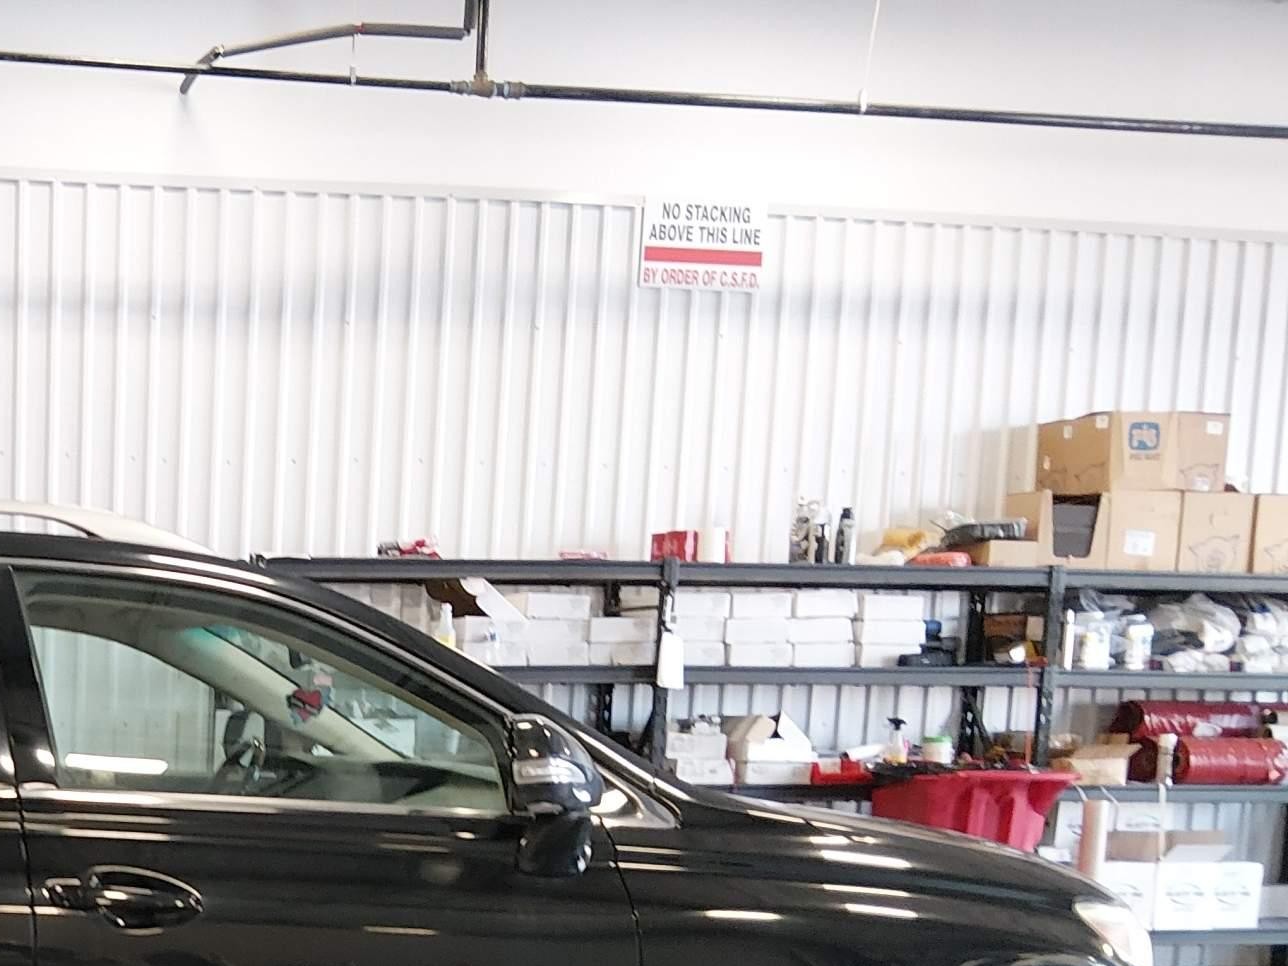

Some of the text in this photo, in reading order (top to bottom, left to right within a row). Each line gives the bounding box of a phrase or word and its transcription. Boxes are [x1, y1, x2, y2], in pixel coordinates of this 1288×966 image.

[662, 202, 751, 223] NO STACKING
[649, 223, 761, 246] ABOVE THIS LINE
[643, 267, 760, 289] BY ORDER OF C.S.F.D.
